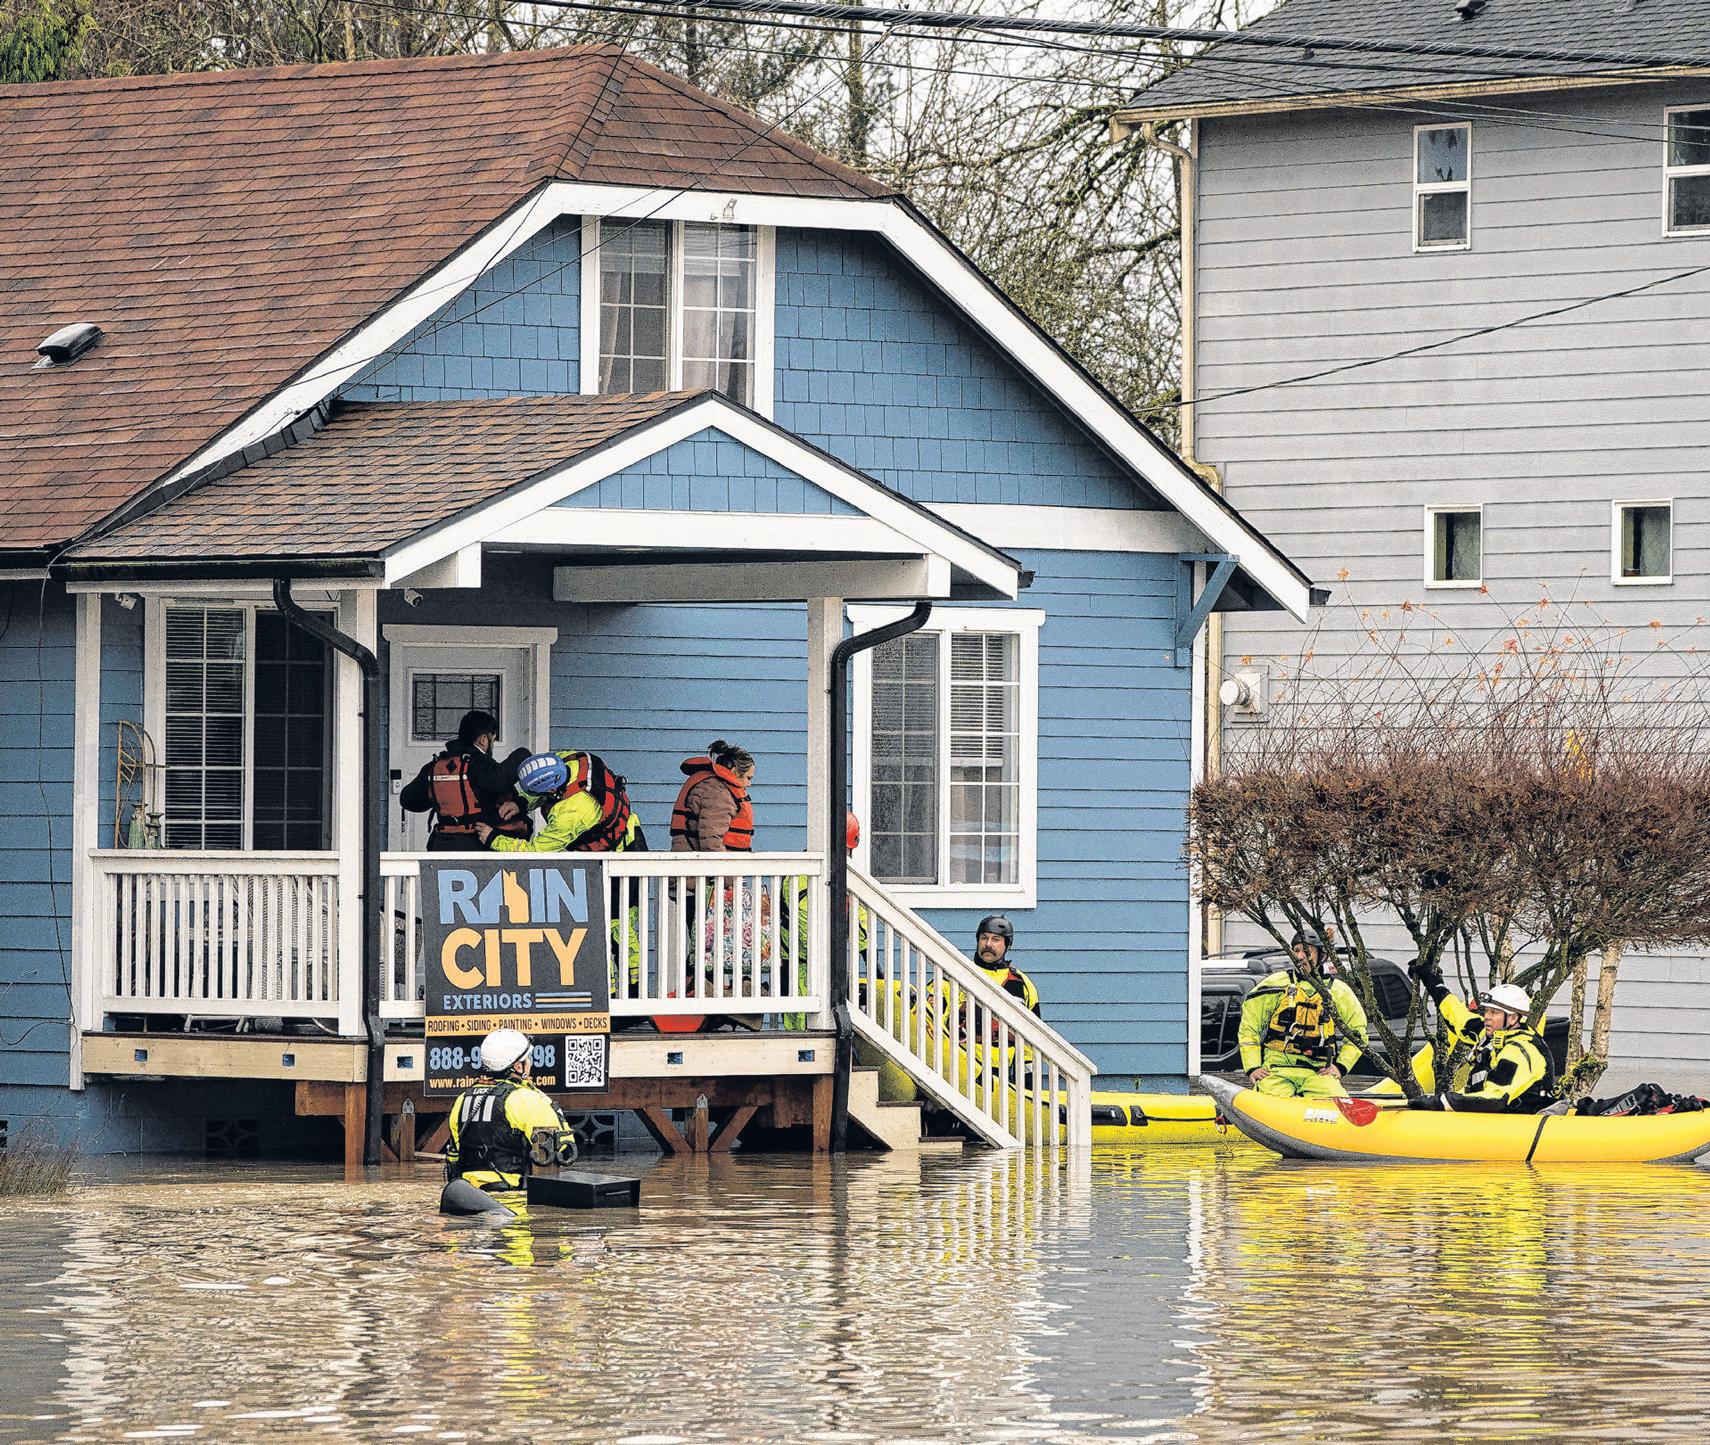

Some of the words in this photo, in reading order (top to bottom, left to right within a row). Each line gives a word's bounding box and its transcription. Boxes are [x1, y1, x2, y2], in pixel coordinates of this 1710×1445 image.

[437, 867, 589, 925] RAIN
[441, 927, 588, 990] CITY
[443, 993, 533, 1011] EXTERIORS
[428, 1019, 460, 1032] ROOFING
[466, 1019, 491, 1031] SIDING
[498, 1018, 532, 1031] PAINTING
[541, 1018, 577, 1030] WINDOWS
[583, 1017, 608, 1029] DECKS
